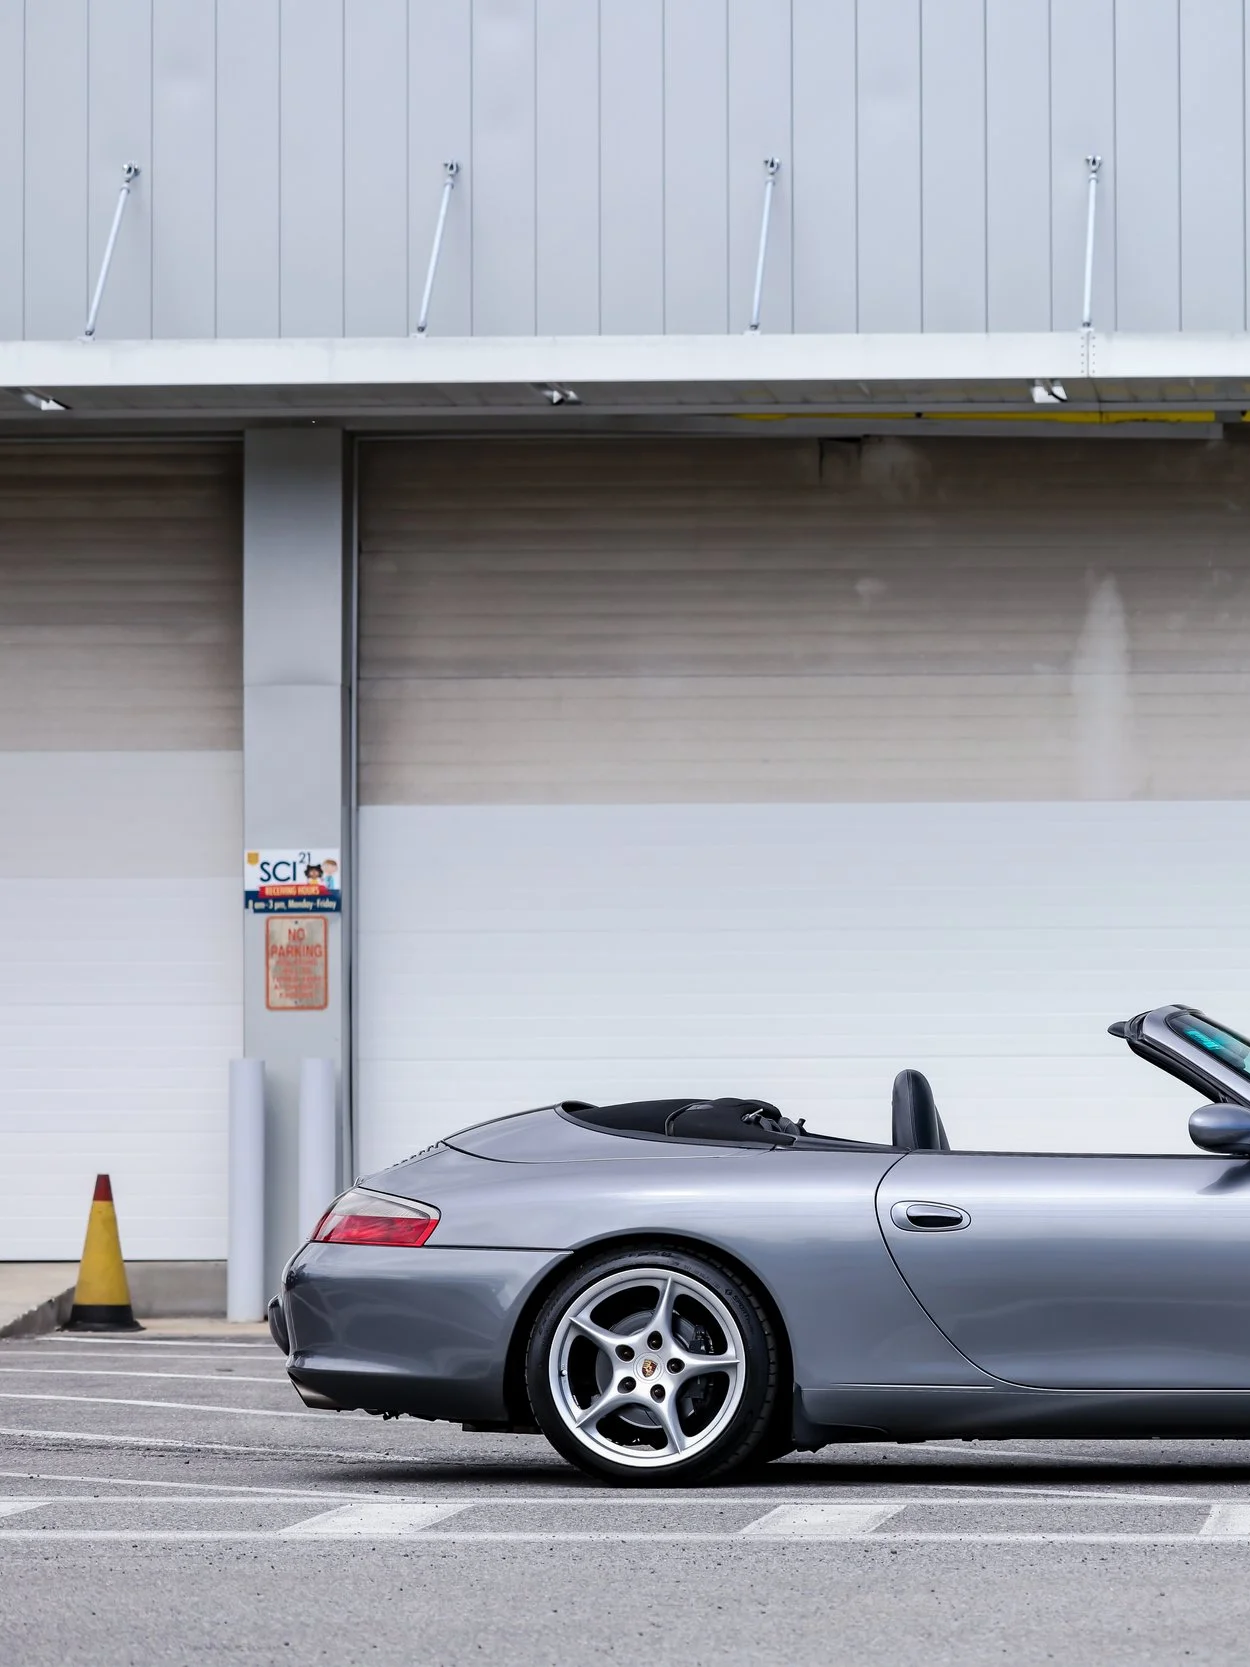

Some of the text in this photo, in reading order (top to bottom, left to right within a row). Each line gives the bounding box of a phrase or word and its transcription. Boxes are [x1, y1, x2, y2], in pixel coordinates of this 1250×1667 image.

[260, 852, 311, 882] SCI 21
[287, 929, 306, 941] NO
[270, 945, 323, 959] PARKING
